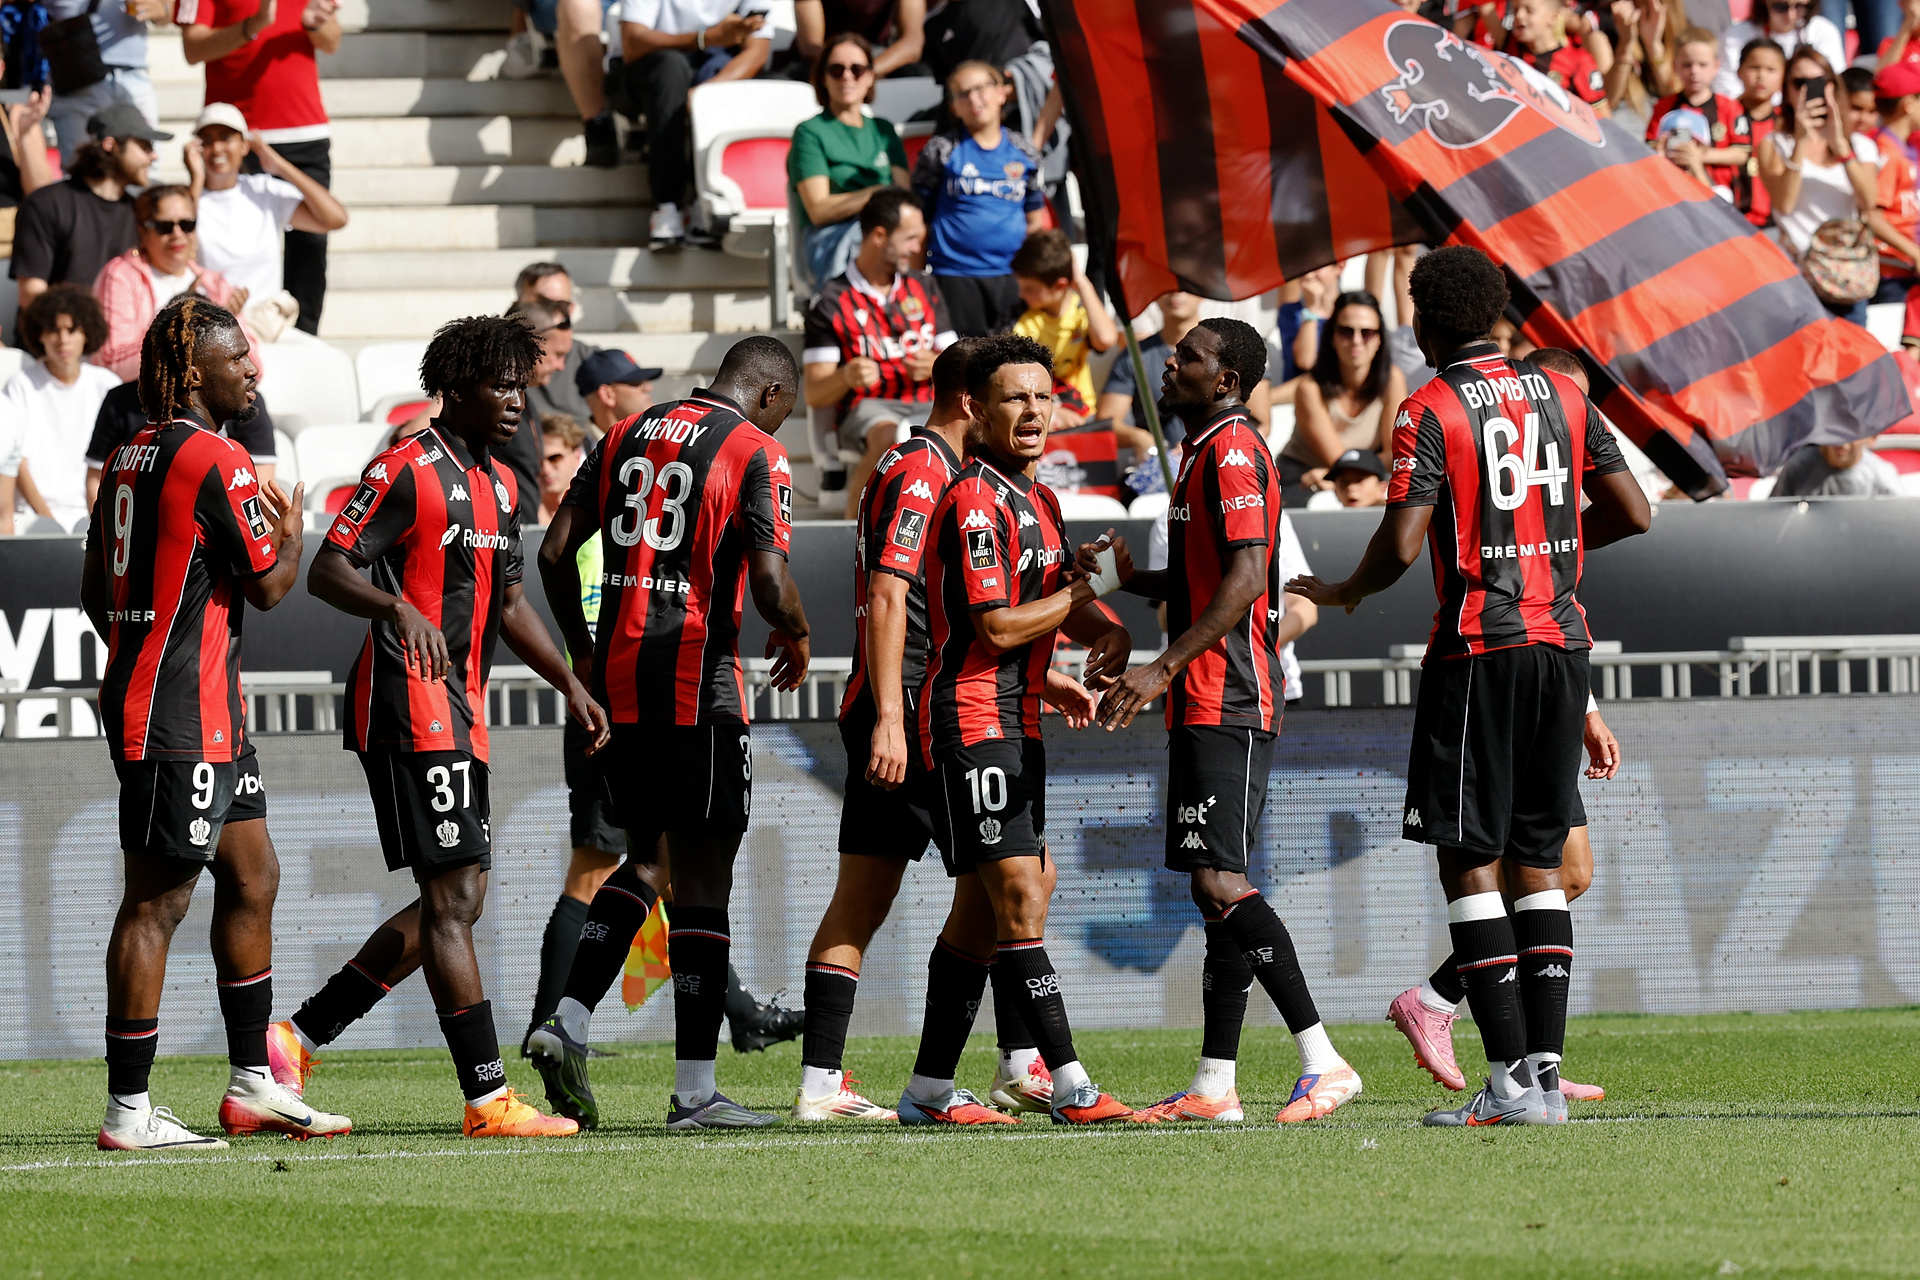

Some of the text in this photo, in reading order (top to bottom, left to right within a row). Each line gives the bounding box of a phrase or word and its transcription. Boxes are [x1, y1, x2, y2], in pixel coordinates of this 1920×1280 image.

[1460, 373, 1551, 409] BOMBTO
[635, 417, 709, 447] MENDY
[415, 446, 444, 467] actual
[1483, 412, 1568, 511] 64
[611, 456, 693, 552] 33
[1219, 494, 1265, 514] INEOS
[113, 483, 134, 577] 9
[463, 528, 509, 550] Robinho
[191, 762, 215, 810] 9
[426, 760, 471, 812] 37
[965, 766, 1007, 814] 10
